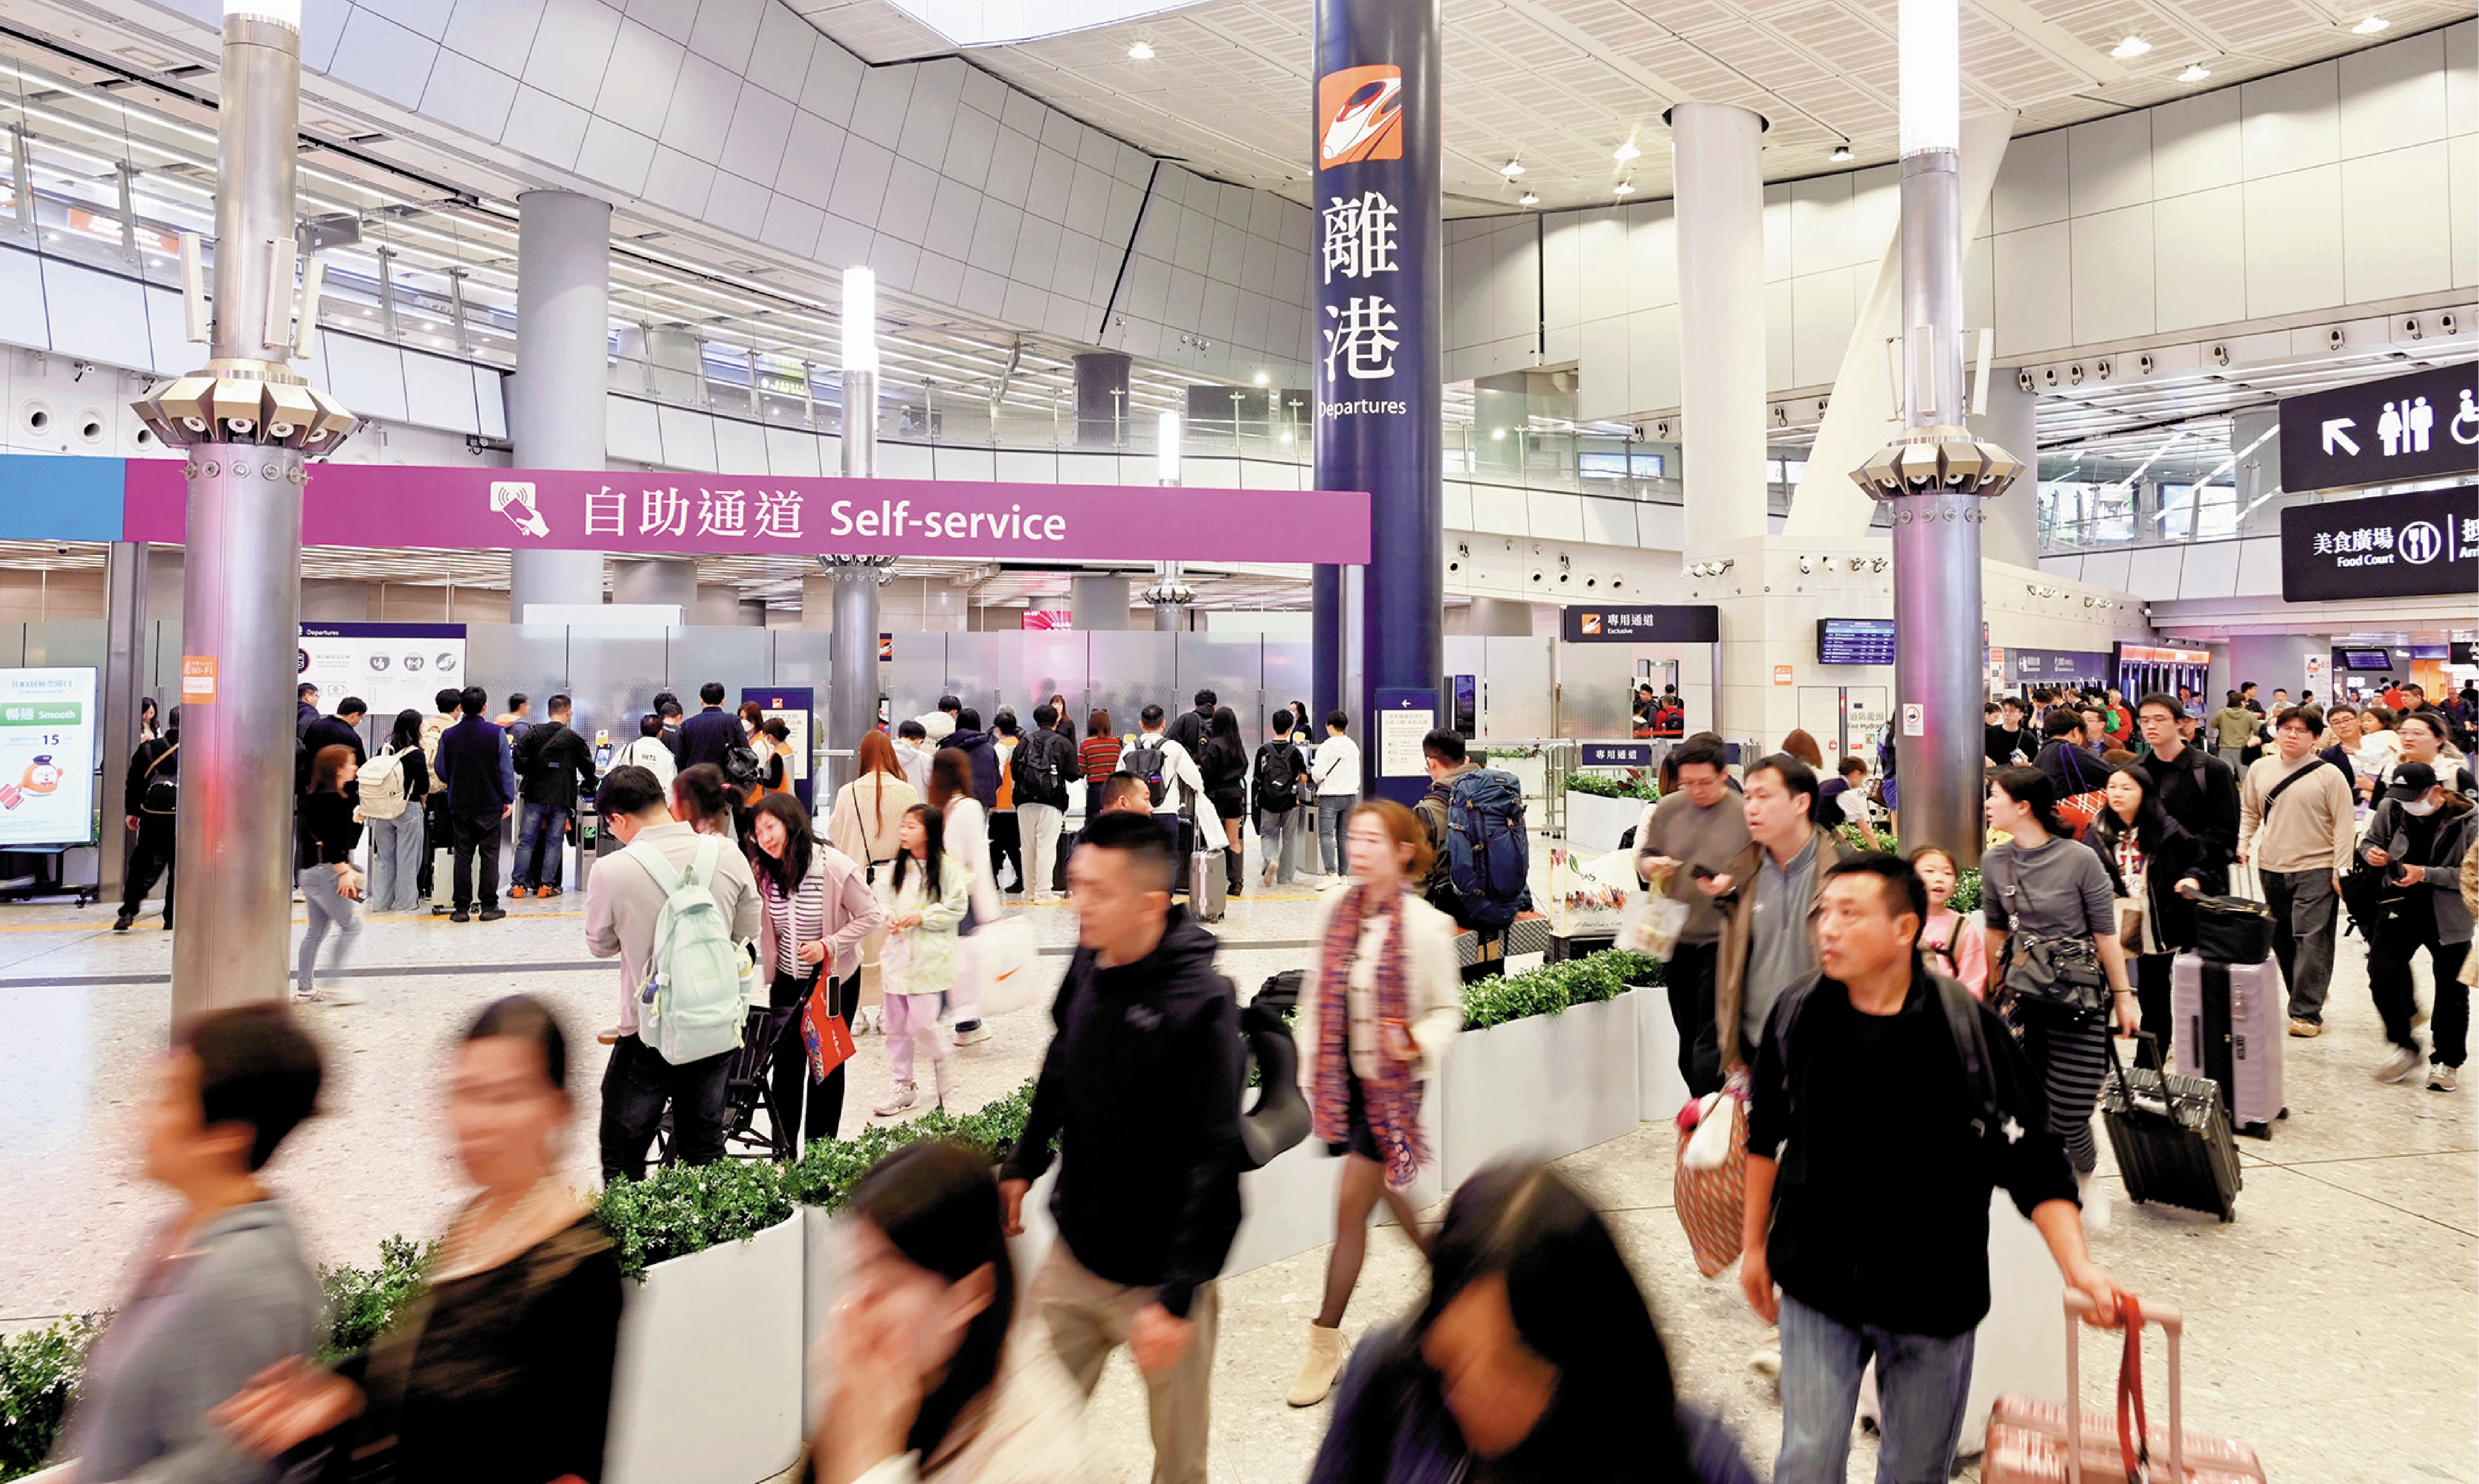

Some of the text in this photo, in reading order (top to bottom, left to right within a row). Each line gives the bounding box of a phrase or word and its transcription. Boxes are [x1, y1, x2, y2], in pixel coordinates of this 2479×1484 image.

[1321, 191, 1400, 382] 離港
[1318, 399, 1407, 419] Departures
[585, 485, 1066, 541] 自助通道 Self-service
[2313, 526, 2394, 555] 美食廣場
[2337, 553, 2395, 567] Food Court
[1607, 613, 1654, 627] 專用通道
[42, 734, 59, 746] 15
